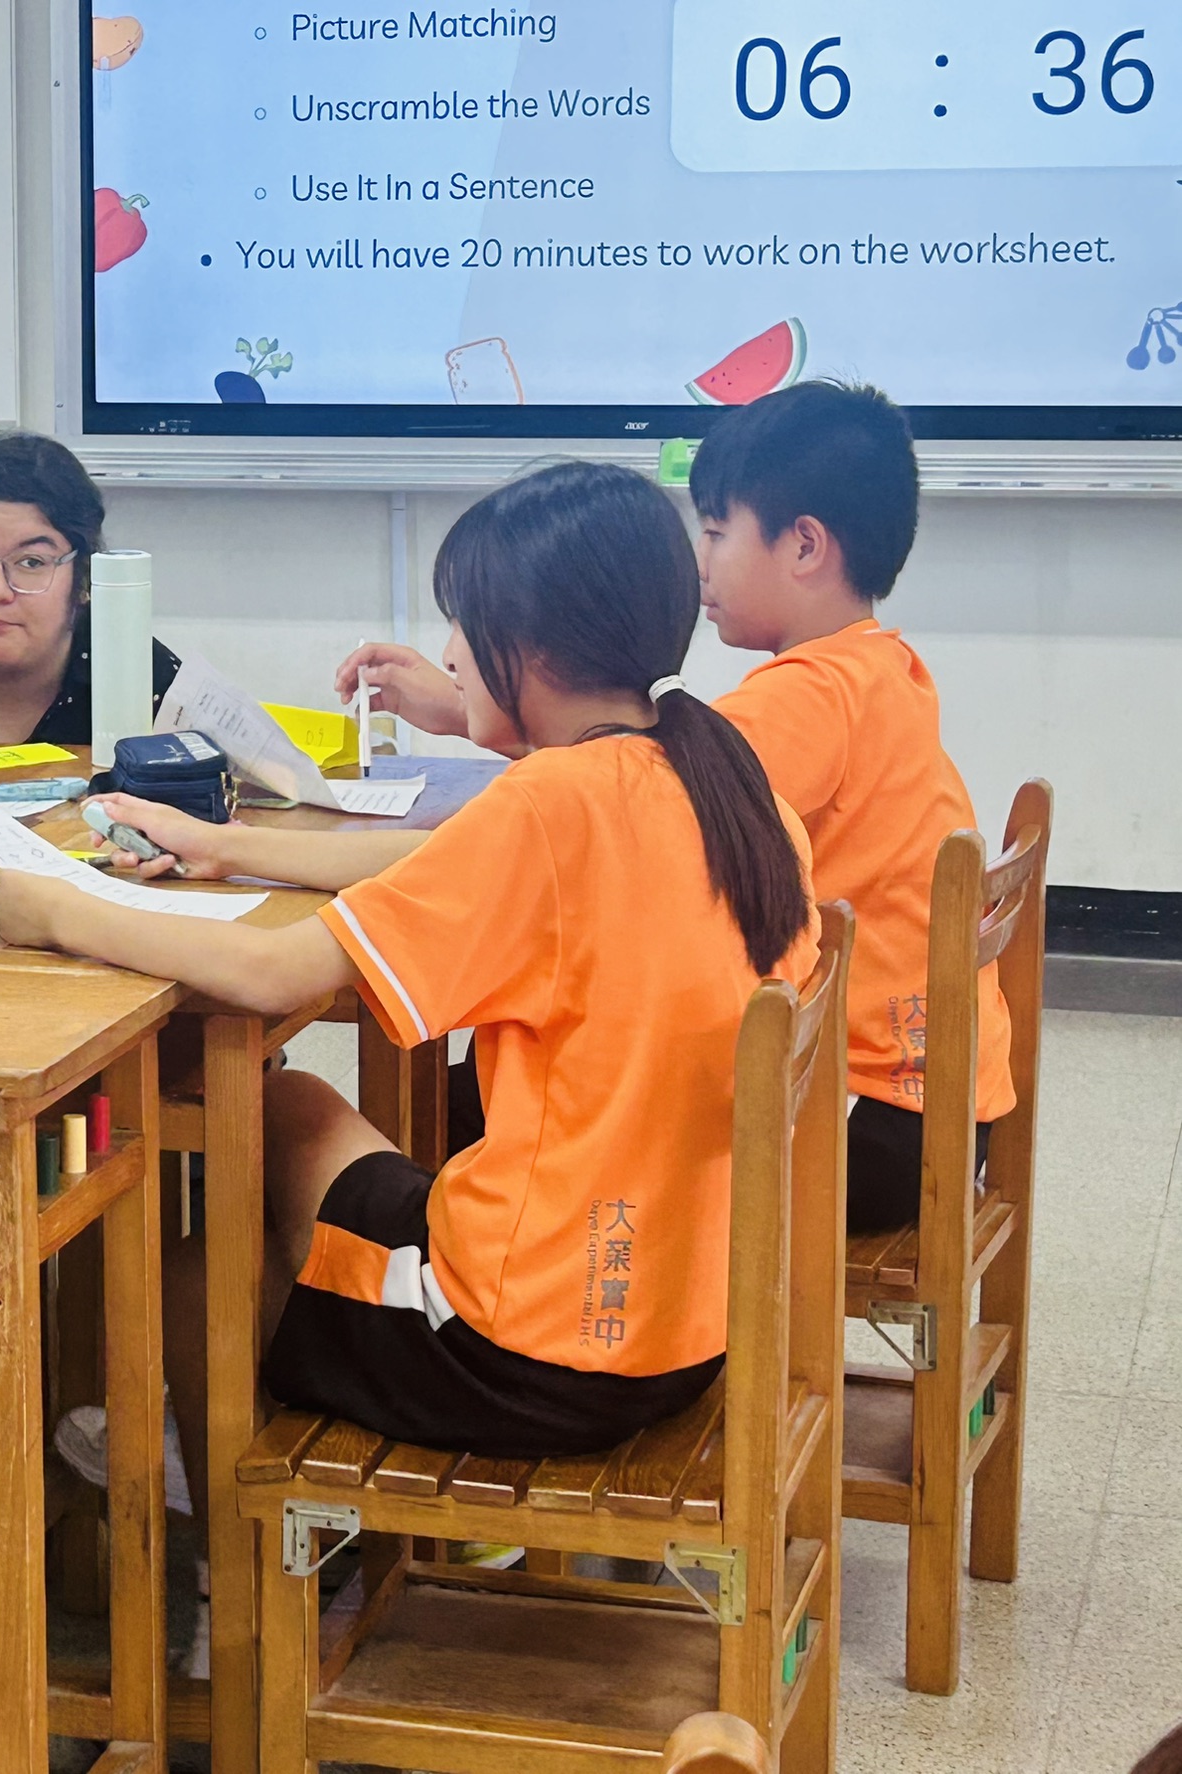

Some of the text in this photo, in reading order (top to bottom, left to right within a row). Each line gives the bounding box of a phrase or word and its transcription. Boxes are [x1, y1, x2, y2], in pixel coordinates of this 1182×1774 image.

[292, 7, 557, 43] Picture Matching
[735, 36, 852, 122] 06
[1031, 28, 1155, 116] 36
[292, 86, 651, 122] Unscramble the Words
[292, 172, 595, 202] Use It In a Sentence
[235, 231, 1116, 270] You will have 20 minutes to work on the worksheet.
